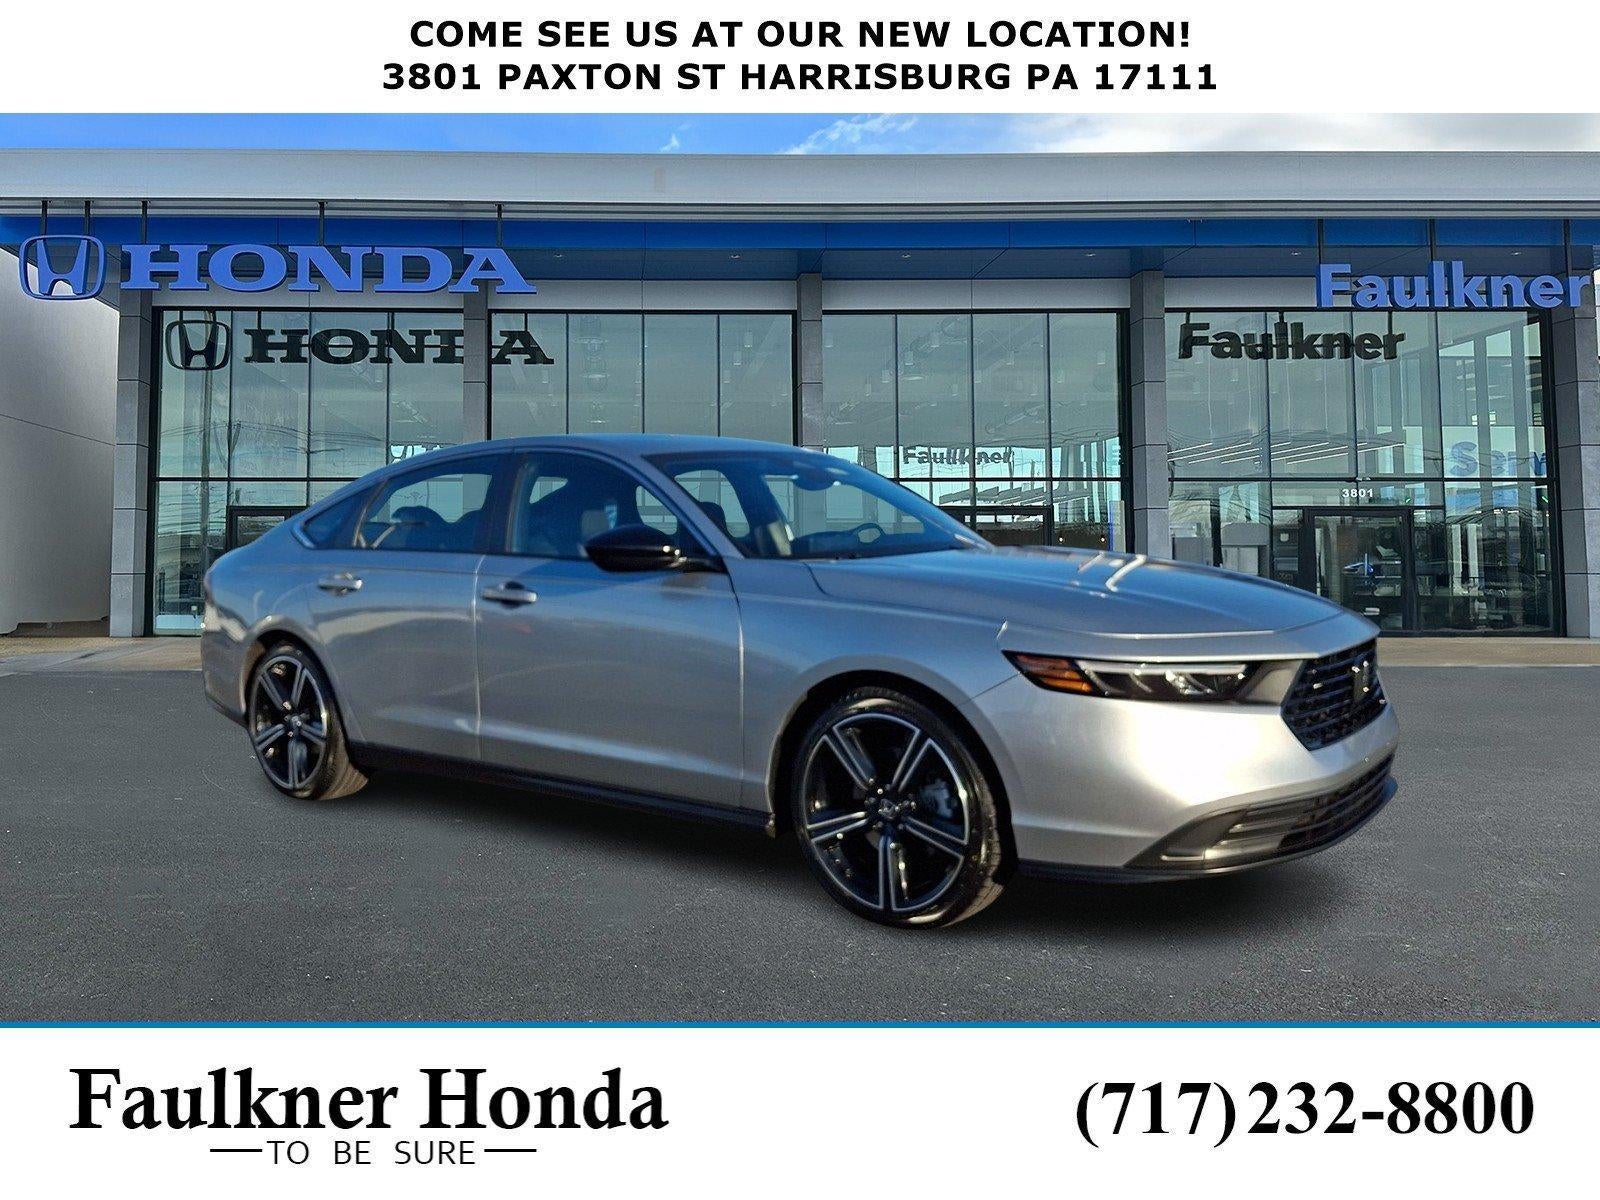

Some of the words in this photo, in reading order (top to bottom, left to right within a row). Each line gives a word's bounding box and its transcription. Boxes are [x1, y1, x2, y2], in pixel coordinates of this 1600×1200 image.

[121, 243, 536, 294] HONDA
[1317, 260, 1590, 307] Faulkner
[1178, 321, 1404, 360] Faulkner
[1342, 488, 1373, 498] 3801
